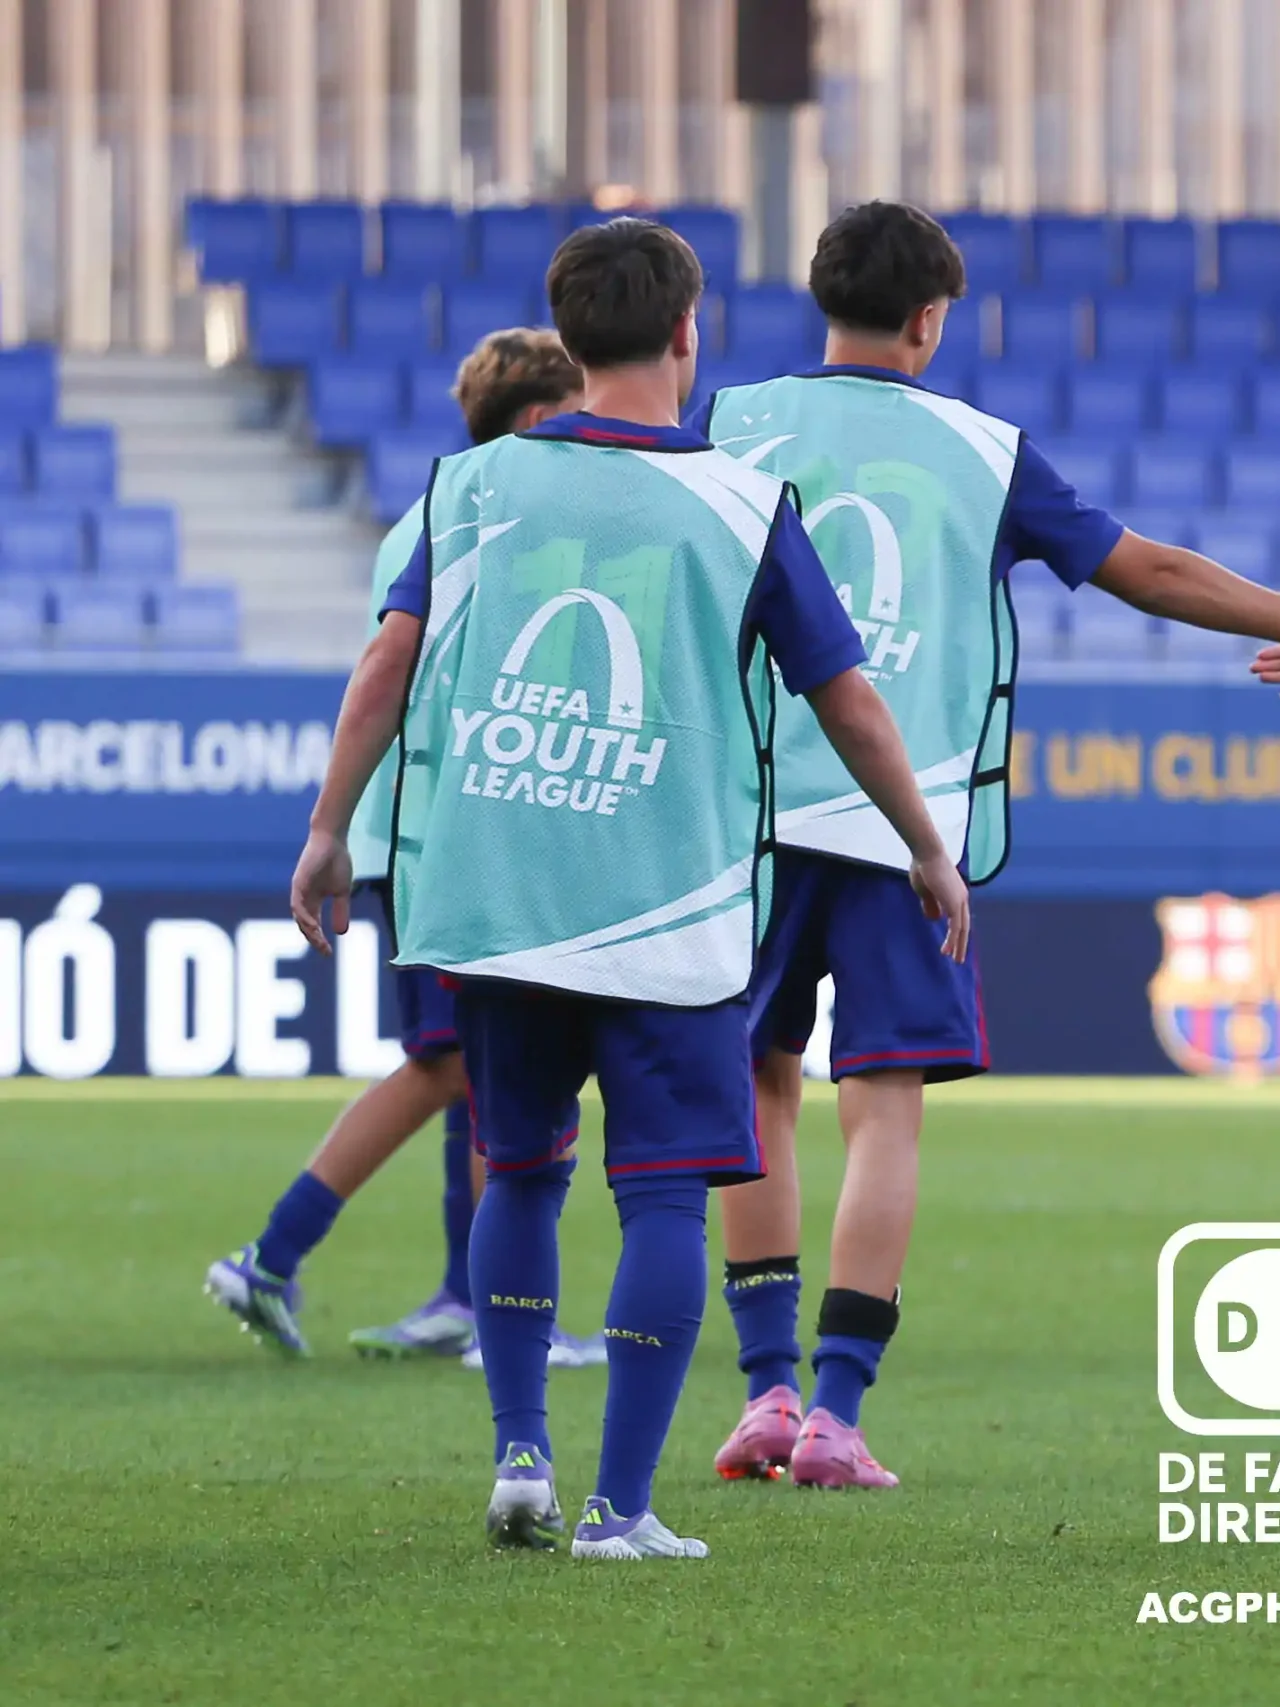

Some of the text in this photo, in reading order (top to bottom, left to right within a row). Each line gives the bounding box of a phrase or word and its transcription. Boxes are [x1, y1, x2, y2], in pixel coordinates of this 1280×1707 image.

[510, 539, 674, 750] 11
[491, 677, 590, 722] UEFA
[451, 707, 668, 786] YOUTH
[1046, 732, 1143, 799] UN
[145, 918, 310, 1078] DE
